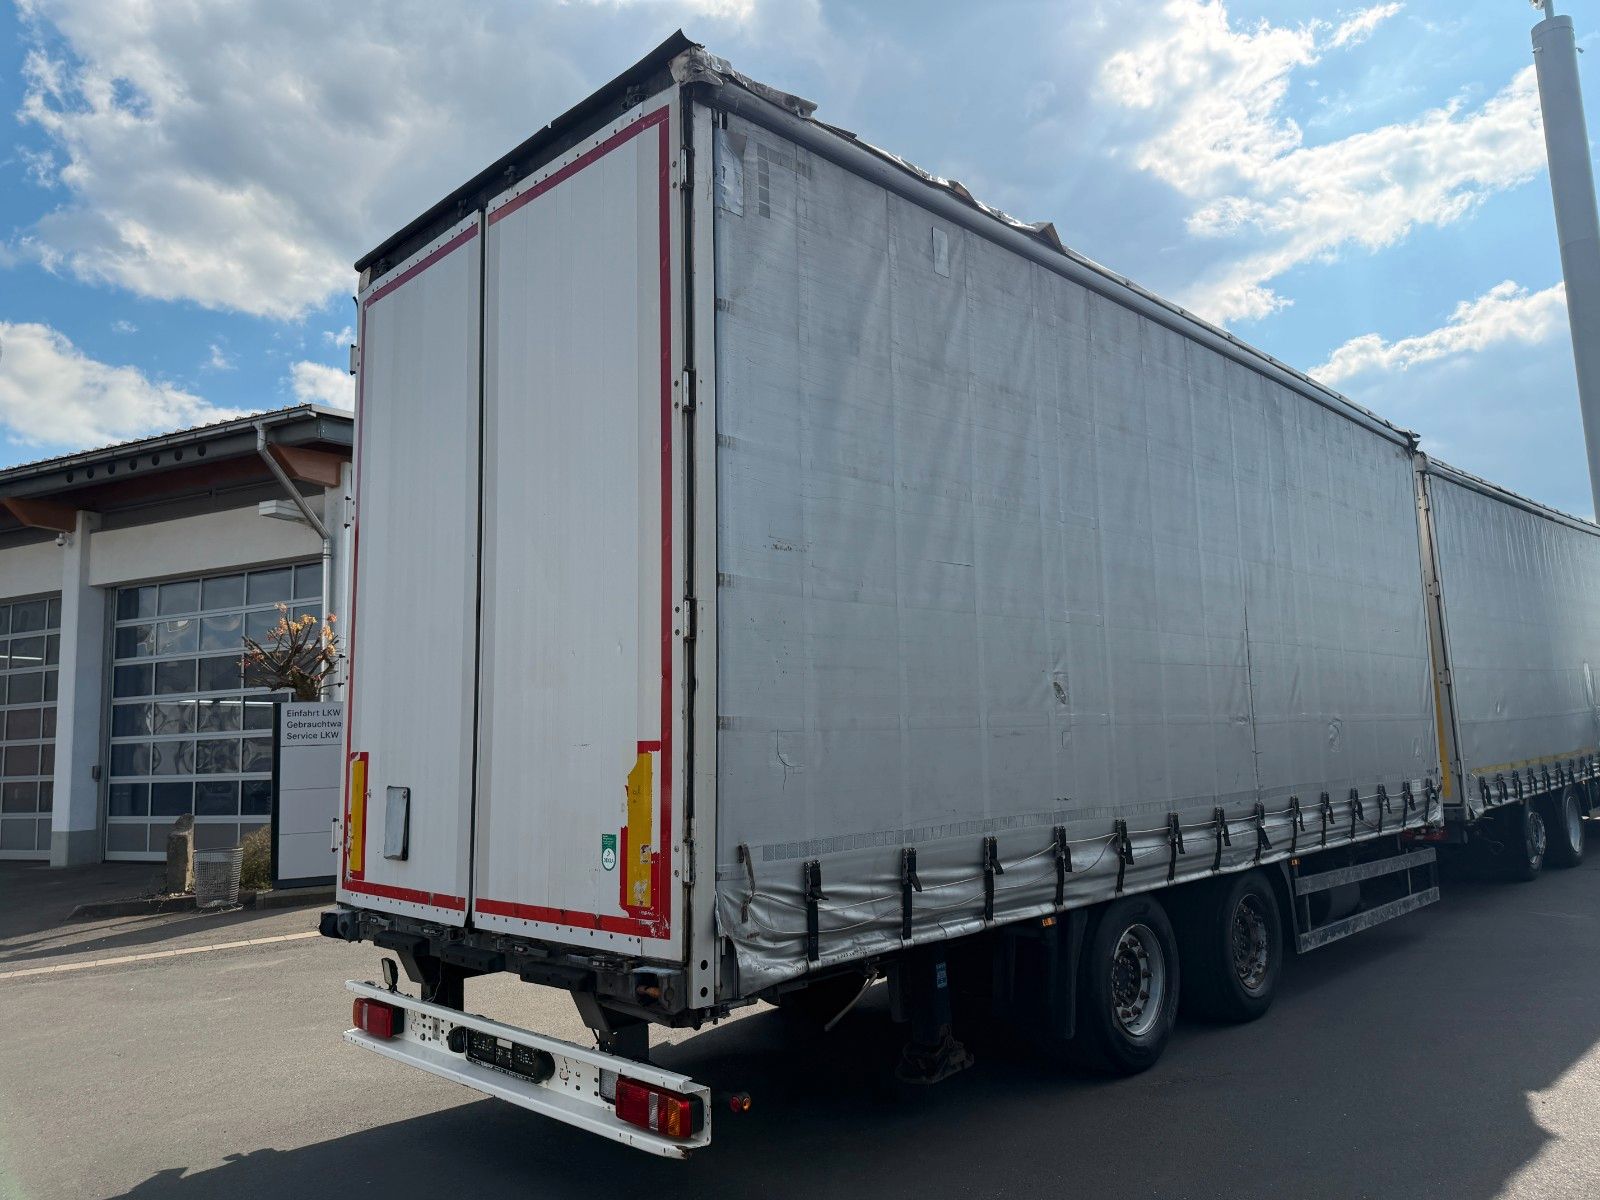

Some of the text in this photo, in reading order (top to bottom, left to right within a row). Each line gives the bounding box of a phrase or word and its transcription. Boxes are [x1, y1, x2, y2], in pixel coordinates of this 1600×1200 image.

[286, 709, 341, 718] Einfahrt LKW
[286, 720, 342, 729] Gebrauchtwa
[286, 731, 339, 740] Service LKW
